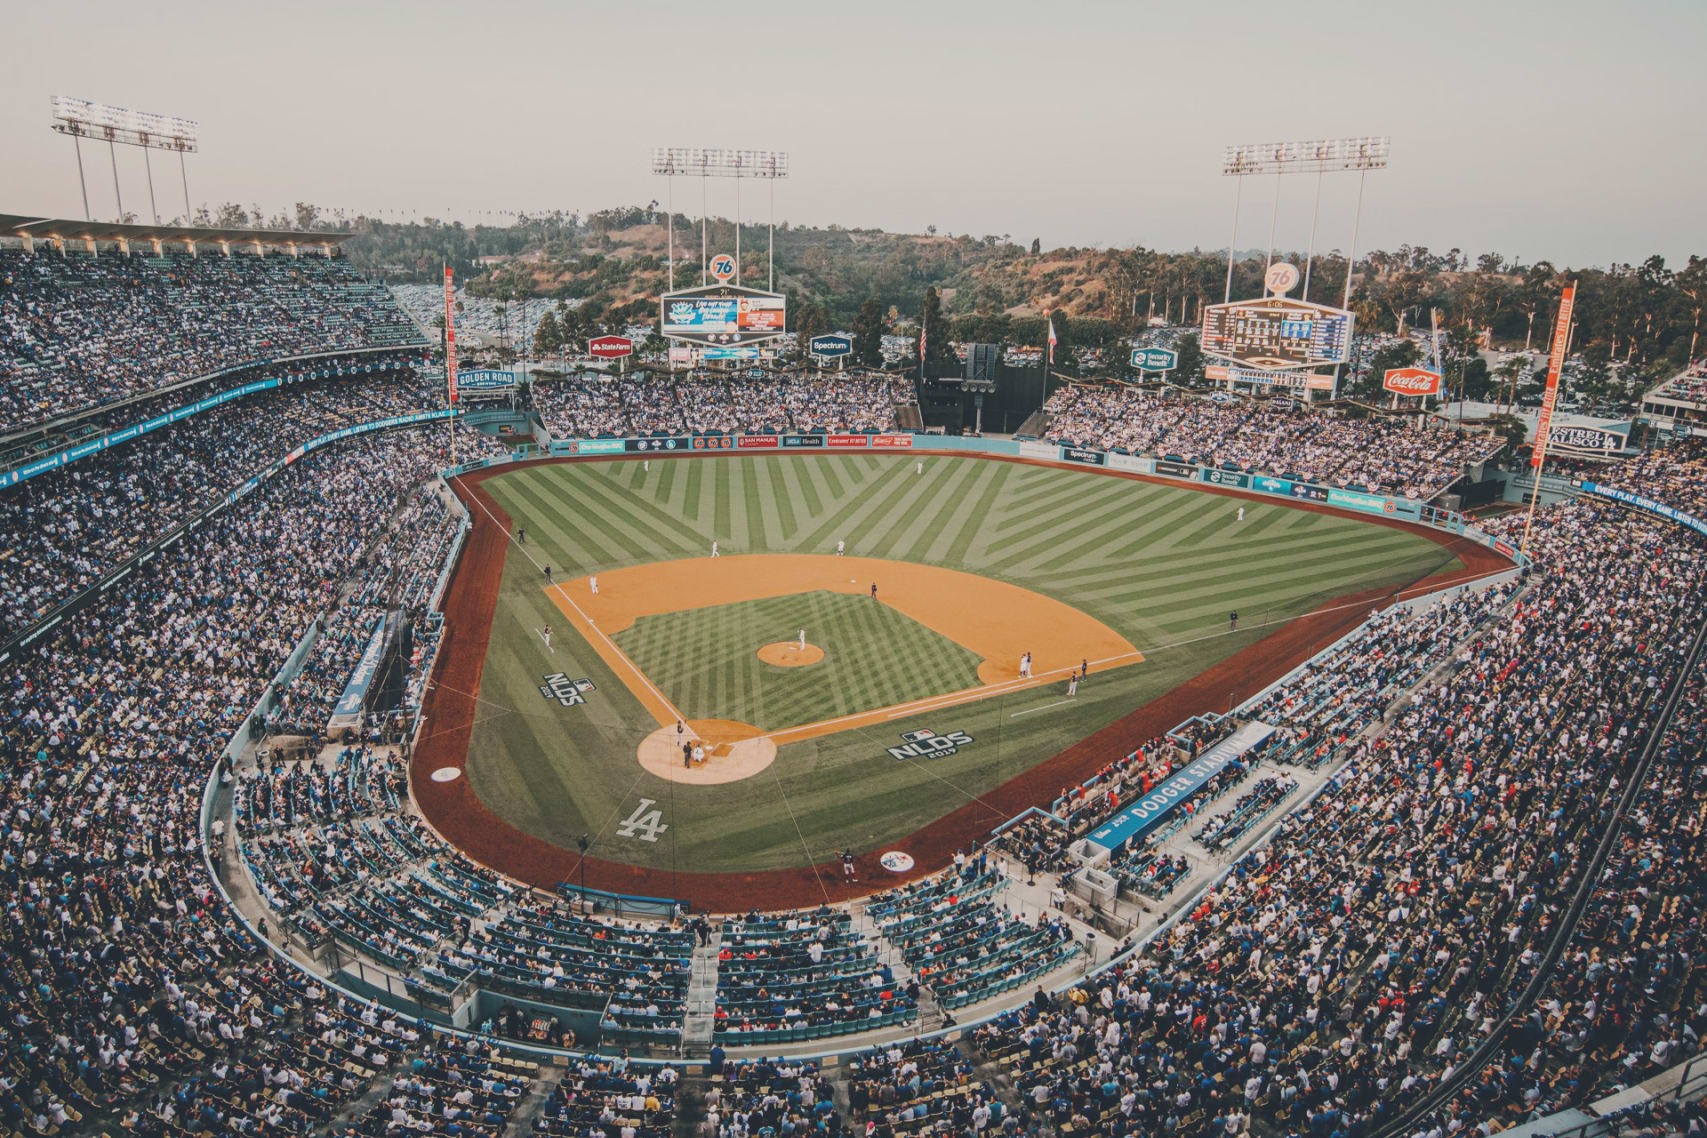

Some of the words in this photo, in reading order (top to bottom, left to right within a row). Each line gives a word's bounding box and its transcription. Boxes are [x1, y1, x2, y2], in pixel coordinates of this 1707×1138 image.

[715, 260, 732, 274] 76
[1270, 270, 1290, 286] 76
[814, 342, 846, 350] Spectrum
[1148, 352, 1172, 362] Security
[460, 372, 490, 385] GOLDEN
[492, 372, 512, 383] ROAD
[1388, 373, 1434, 391] Coca-Cola
[1070, 451, 1096, 459] Spectrum
[1594, 484, 1617, 496] EVERY
[1636, 496, 1656, 510] EVERY
[1674, 510, 1692, 525] LISTEN
[544, 672, 584, 706] NLDS
[888, 731, 974, 760] NLDS
[927, 747, 957, 759] 2019
[1130, 776, 1195, 820] DODGER
[1189, 740, 1246, 778] STADIUM
[615, 798, 669, 842] LA
